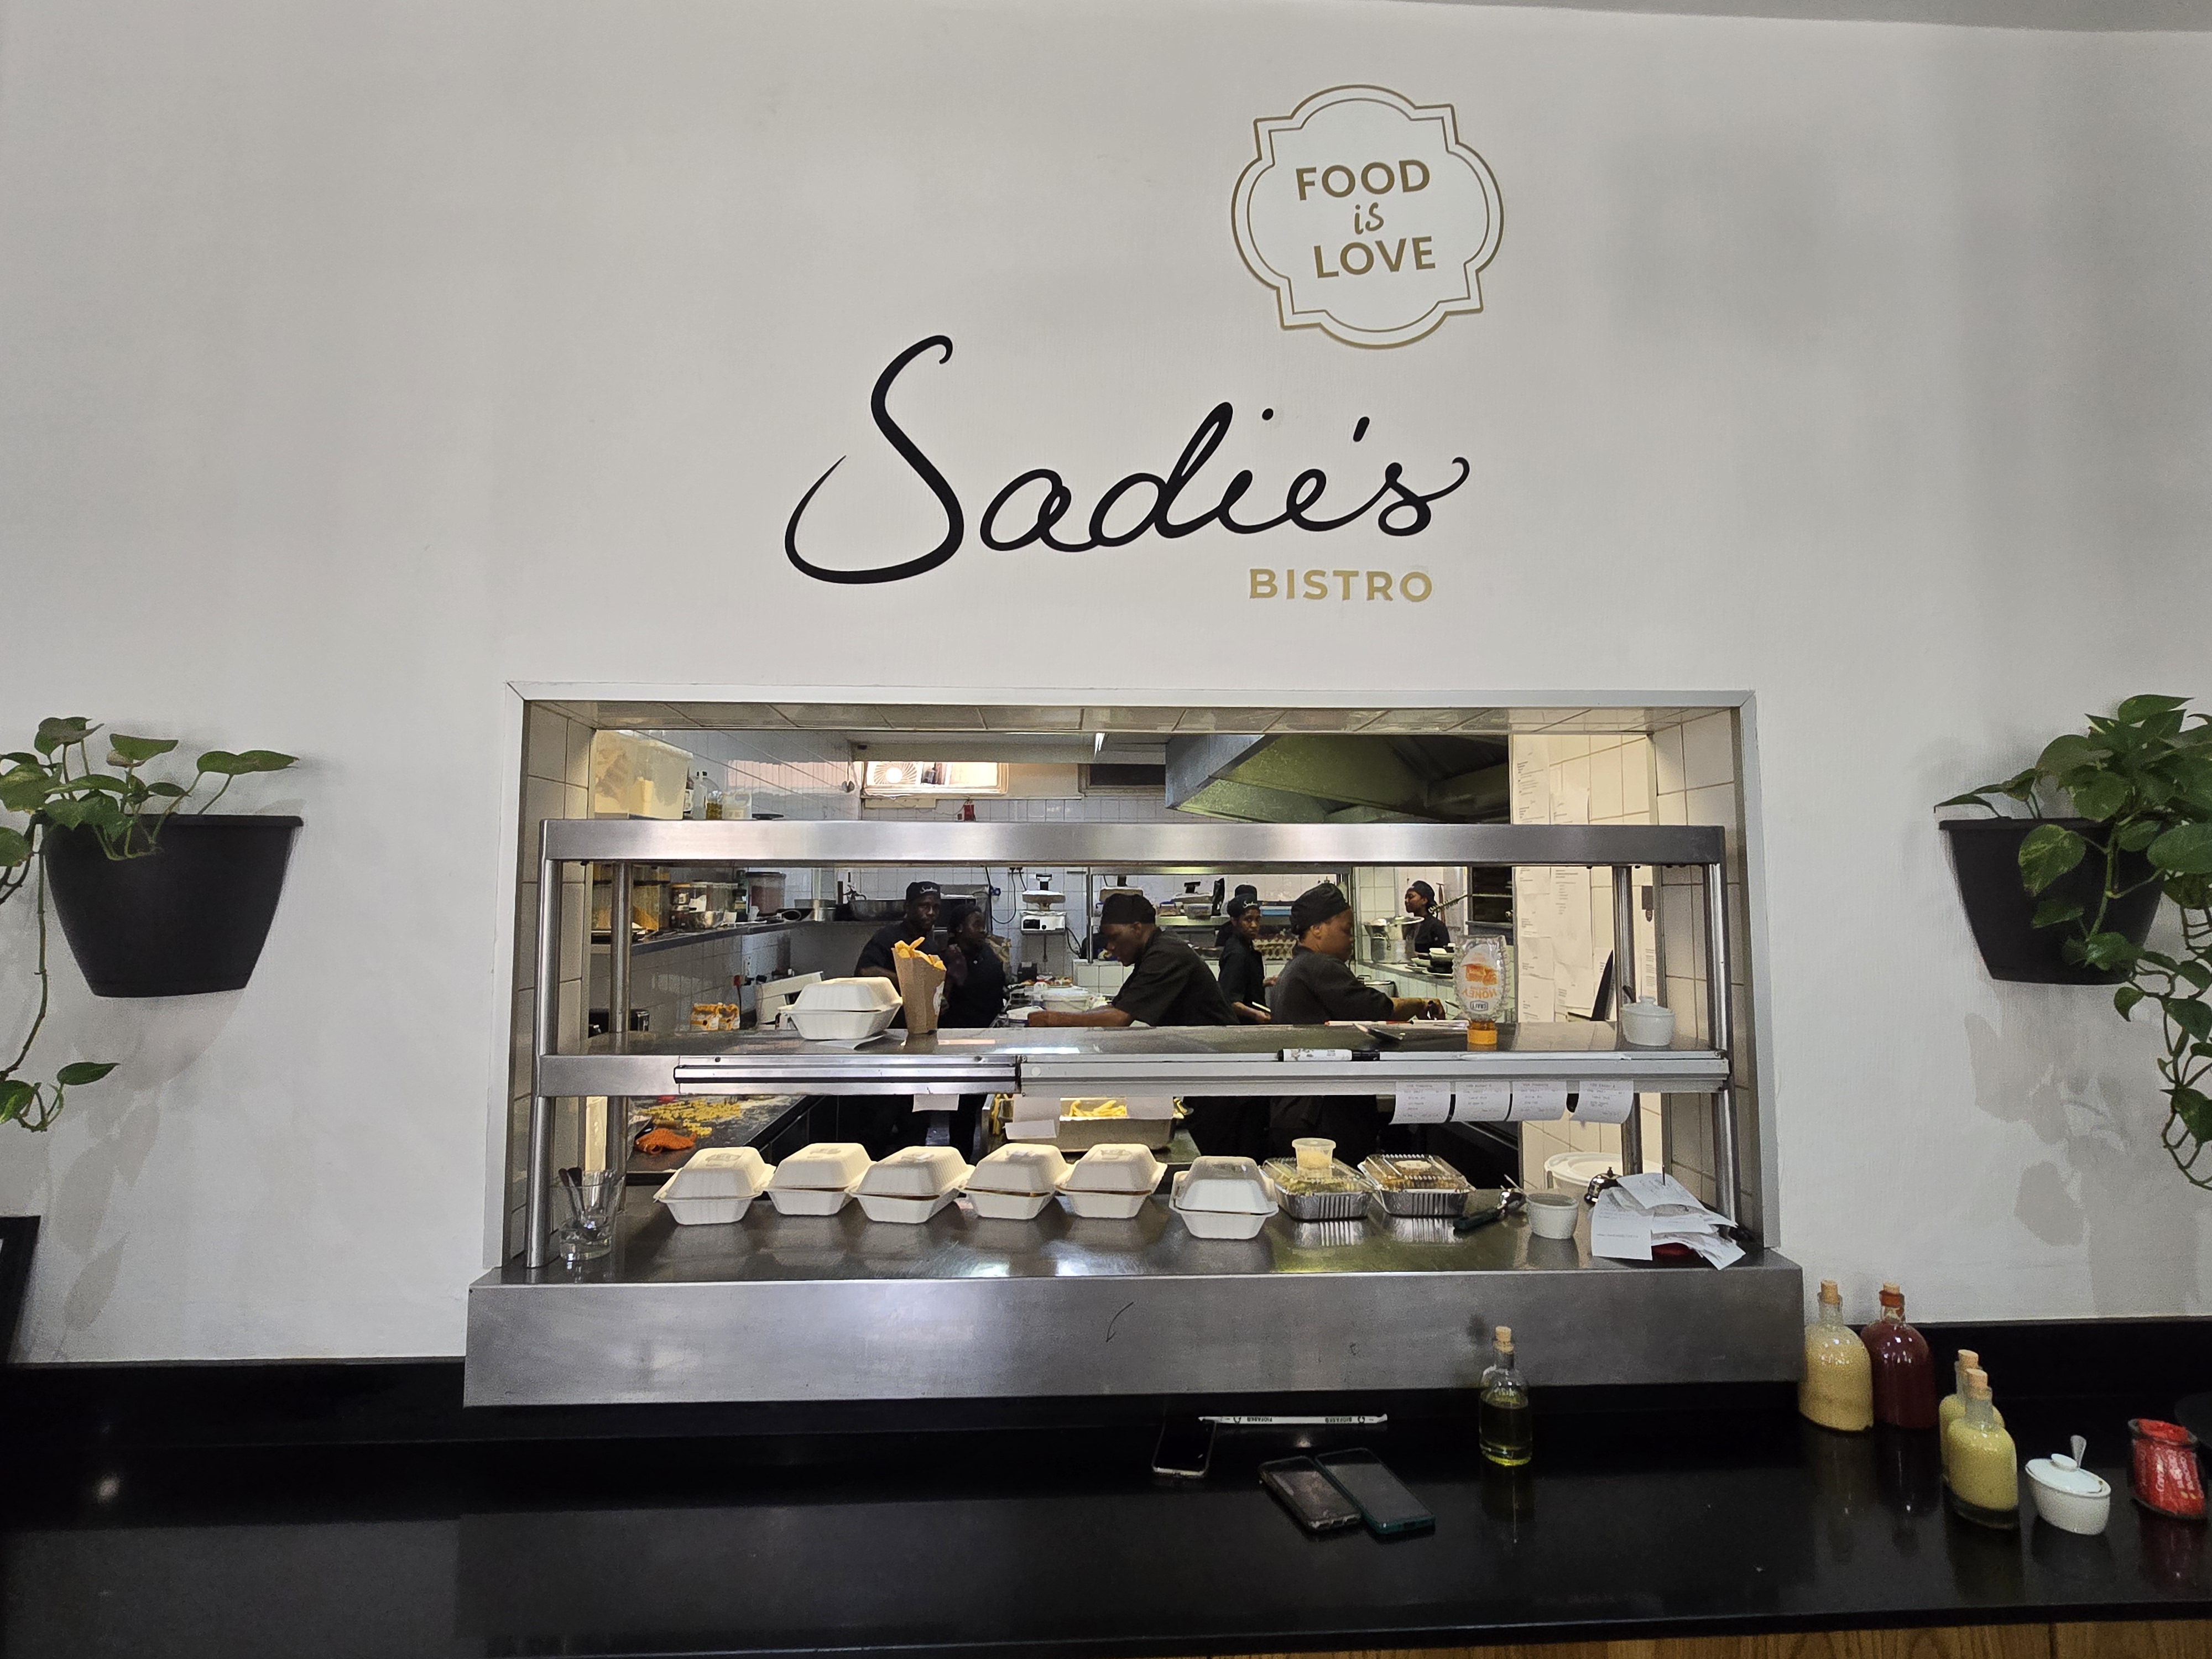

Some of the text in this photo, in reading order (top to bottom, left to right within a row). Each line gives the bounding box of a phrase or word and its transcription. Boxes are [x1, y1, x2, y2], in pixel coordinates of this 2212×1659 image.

[1296, 159, 1430, 201] FOOD
[1354, 202, 1384, 234] is
[1313, 236, 1436, 279] LOVE
[784, 335, 1470, 584] Sadie's
[1249, 568, 1433, 602] BISTRO
[1462, 989, 1497, 999] HONEY
